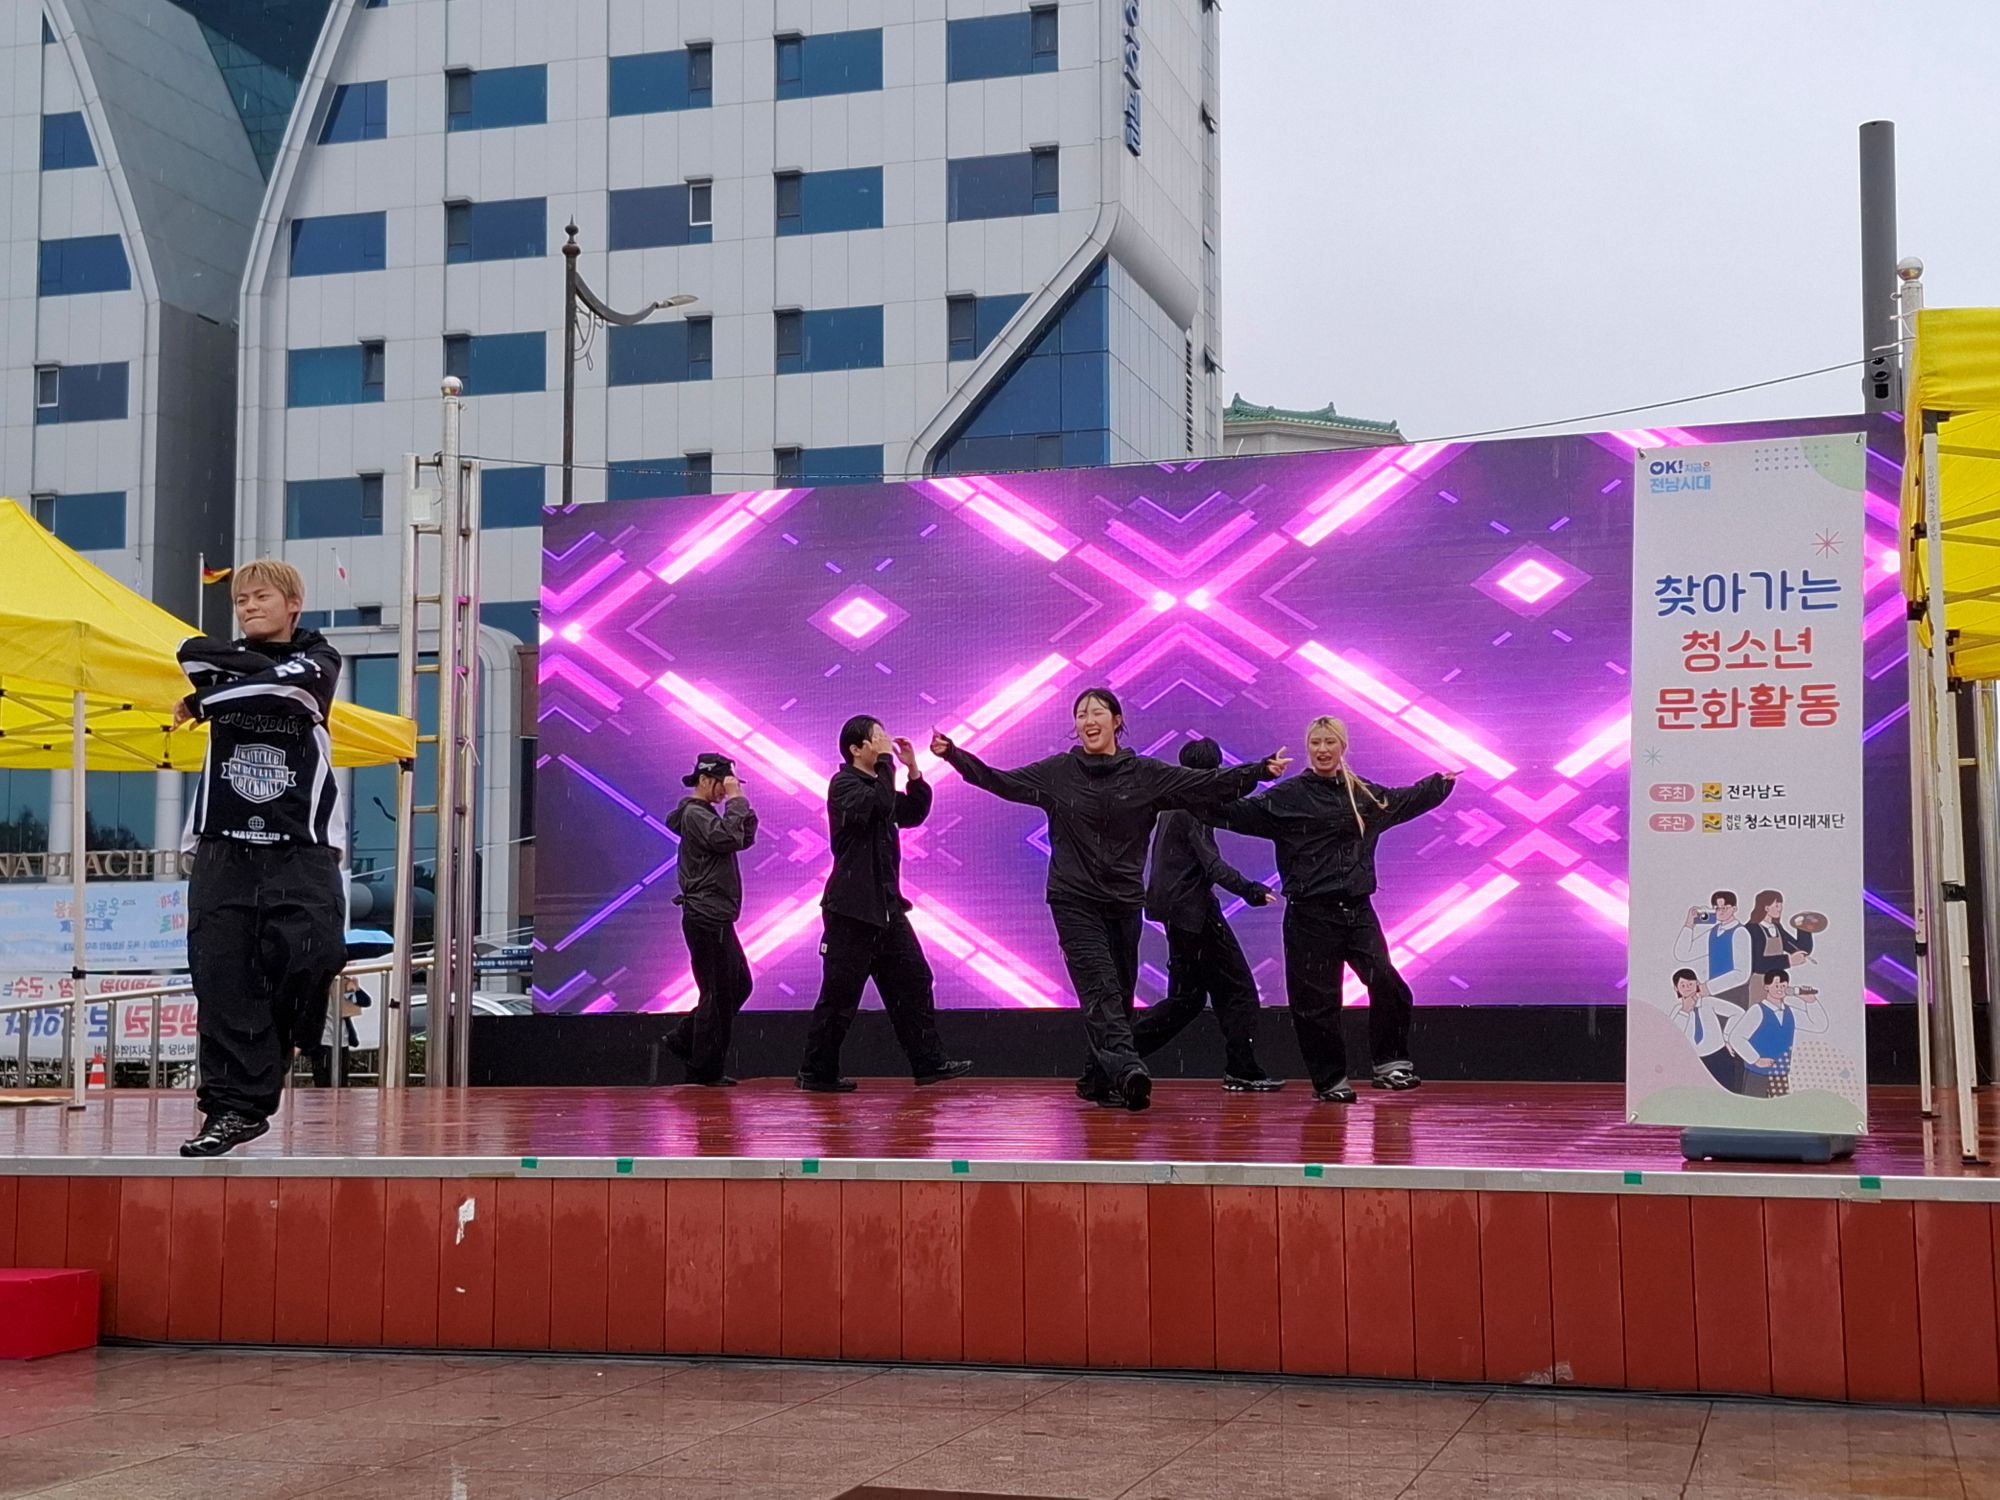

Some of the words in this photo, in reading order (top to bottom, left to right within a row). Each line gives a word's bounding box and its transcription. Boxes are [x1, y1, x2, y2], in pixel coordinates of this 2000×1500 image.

[1649, 460, 1683, 475] OK!
[1650, 475, 1711, 493] 전남시대
[1655, 570, 1842, 616] 찾아가는
[1682, 627, 1812, 672] 청소년
[1655, 683, 1841, 729] 문화활동
[1658, 786, 1687, 800] 주최
[1728, 784, 1787, 799] 전라남도
[1658, 816, 1687, 831] 주관
[1745, 813, 1845, 830] 청소년미래재단
[231, 830, 280, 841] WAVECLUB
